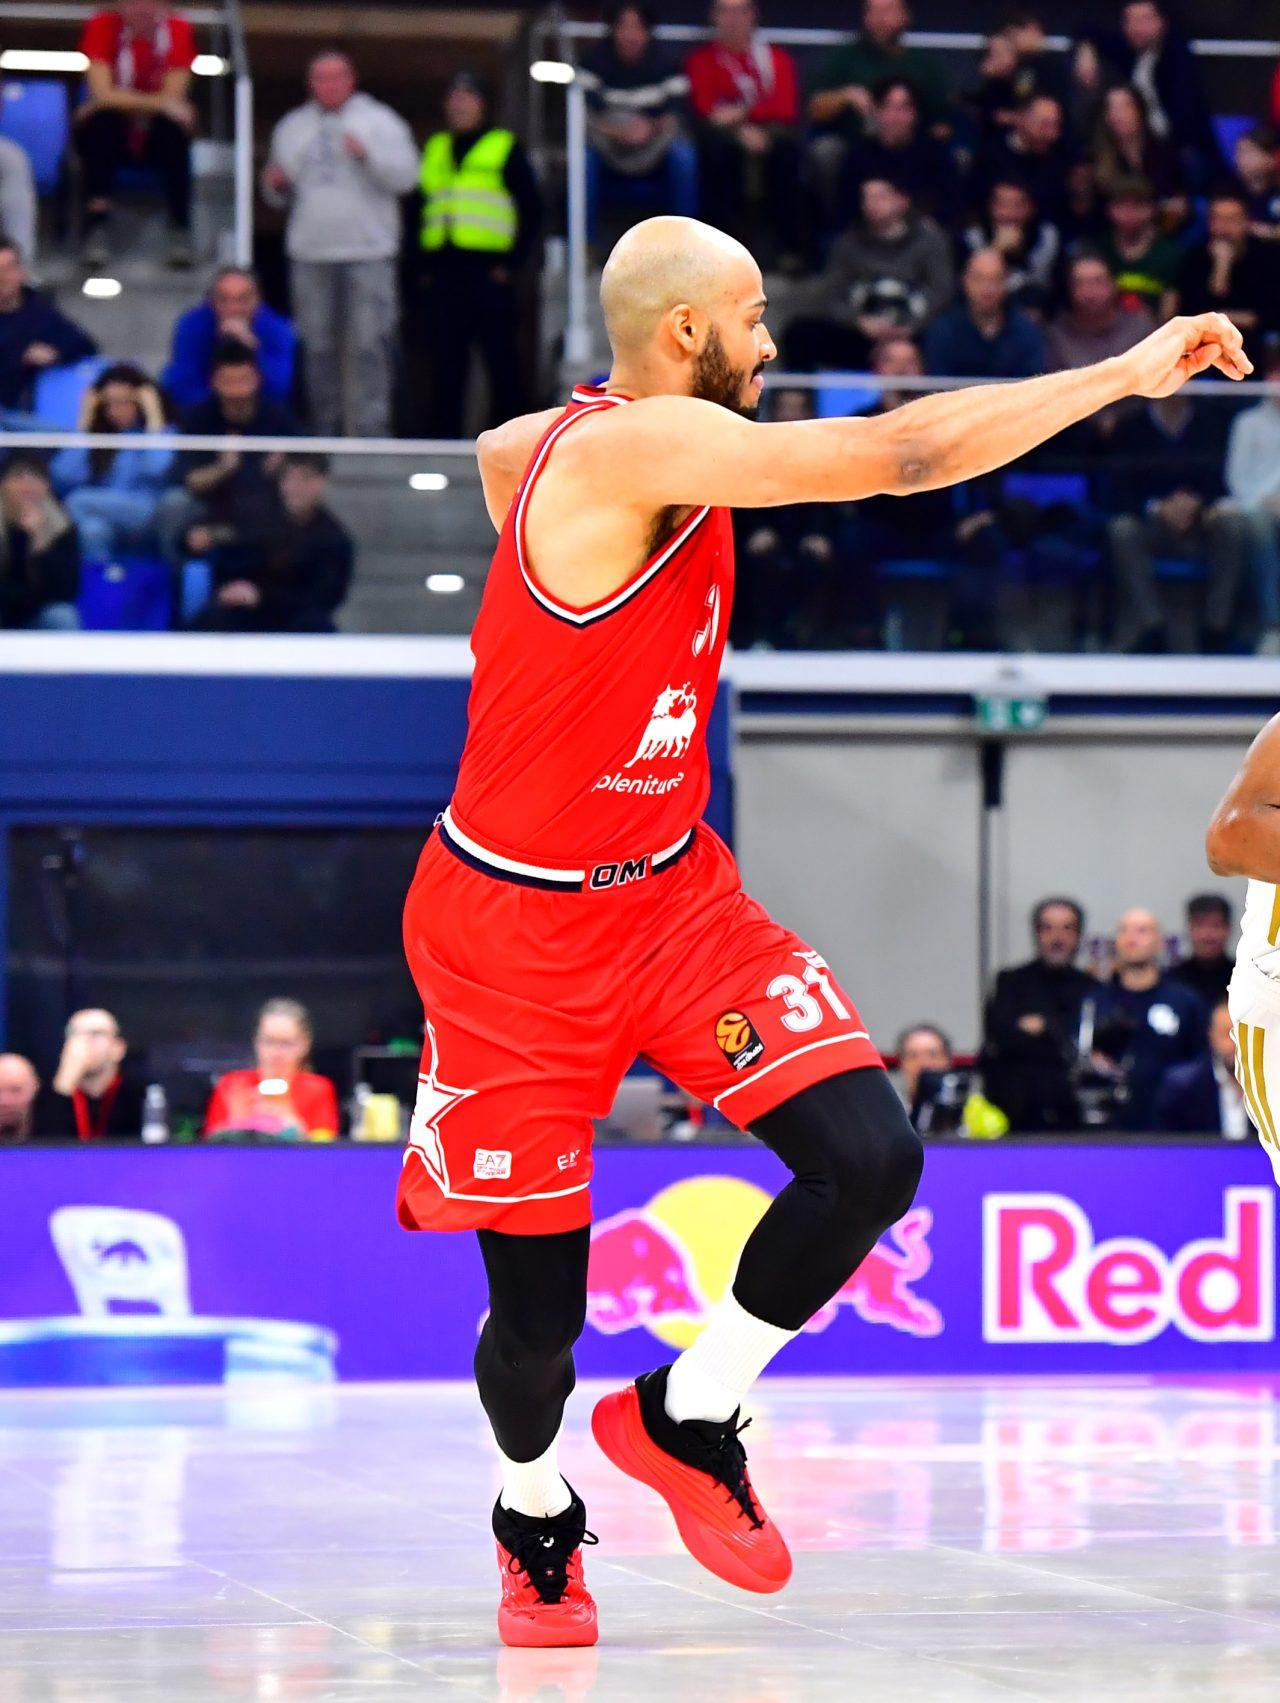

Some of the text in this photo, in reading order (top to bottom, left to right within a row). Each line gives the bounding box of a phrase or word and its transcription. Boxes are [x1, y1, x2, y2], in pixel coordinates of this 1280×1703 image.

[590, 853, 651, 890] OM
[766, 965, 851, 1033] 31
[982, 1185, 1276, 1344] Red
